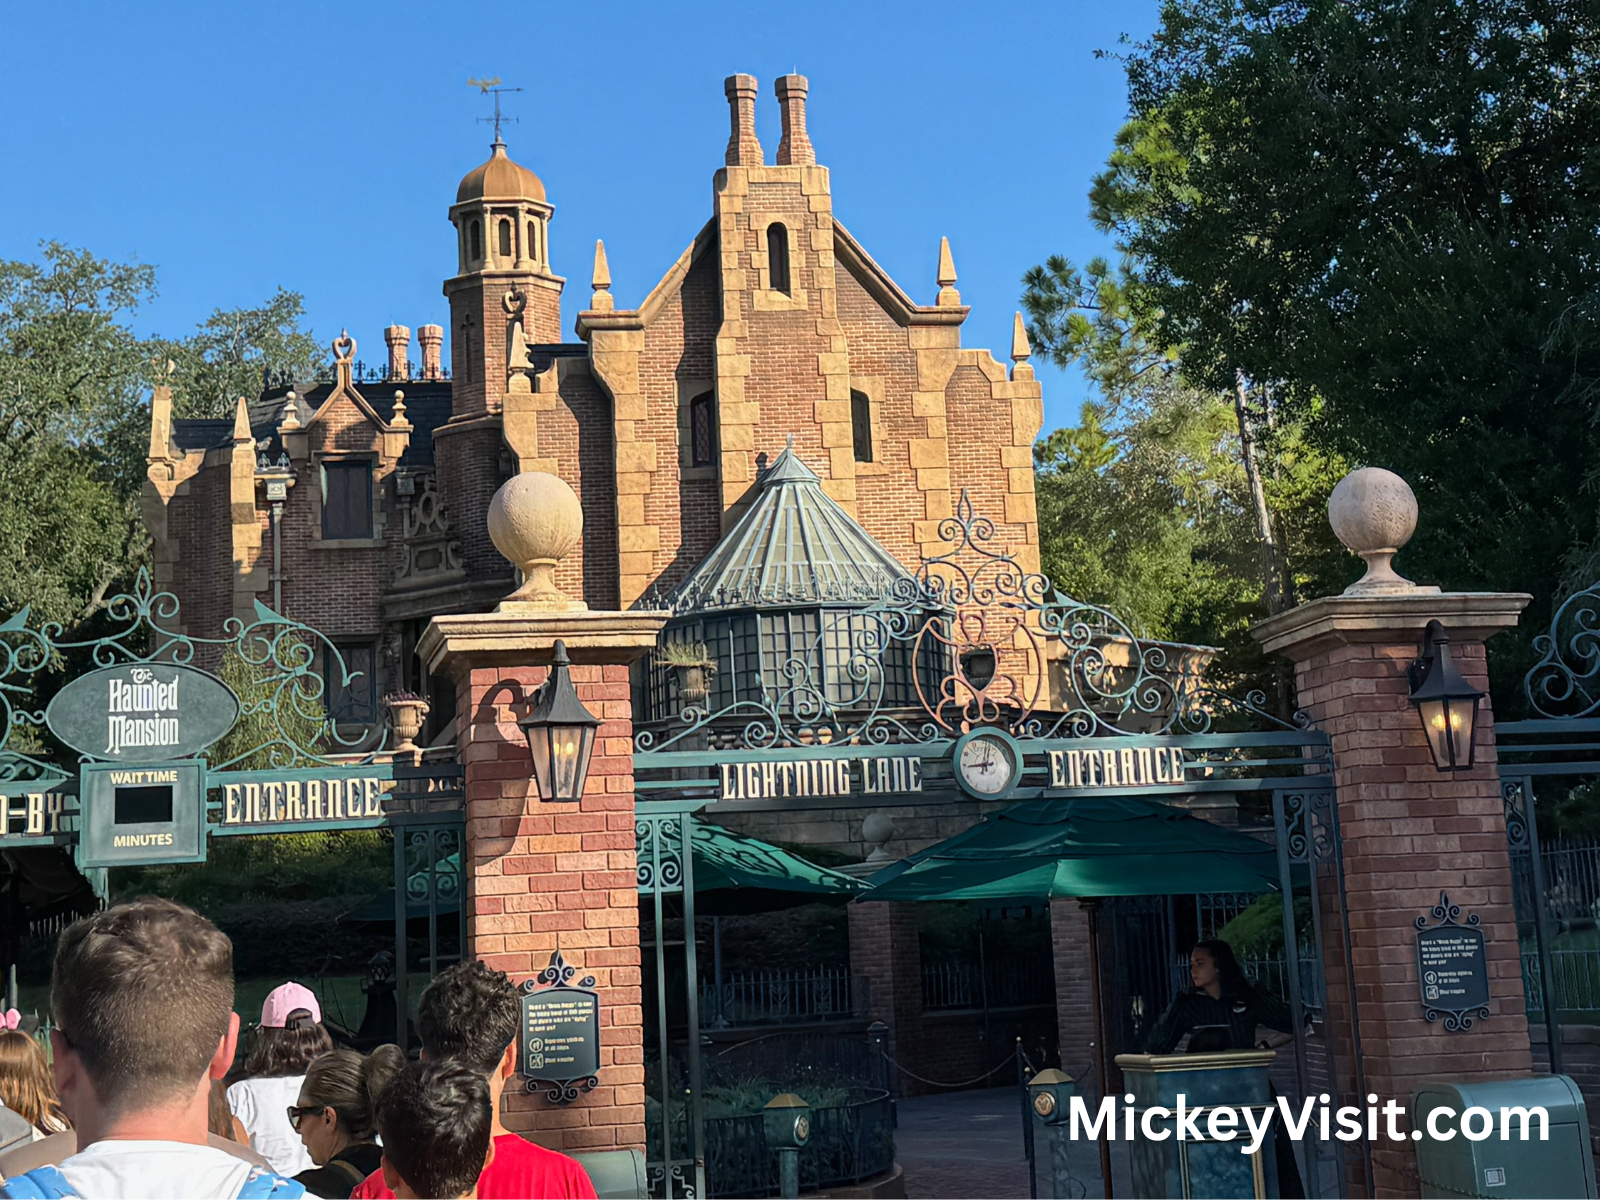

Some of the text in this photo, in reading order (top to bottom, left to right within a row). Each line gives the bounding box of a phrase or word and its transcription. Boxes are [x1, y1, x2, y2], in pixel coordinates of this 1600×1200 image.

[108, 674, 180, 713] Haunted
[104, 712, 180, 755] Mansion
[110, 770, 178, 785] WAIT TIME
[721, 759, 850, 800] LIGHTNING
[861, 756, 922, 794] LANE
[1049, 746, 1185, 787] ENTRANCE
[224, 777, 381, 824] ENTRANCE
[113, 833, 173, 848] MINUTES
